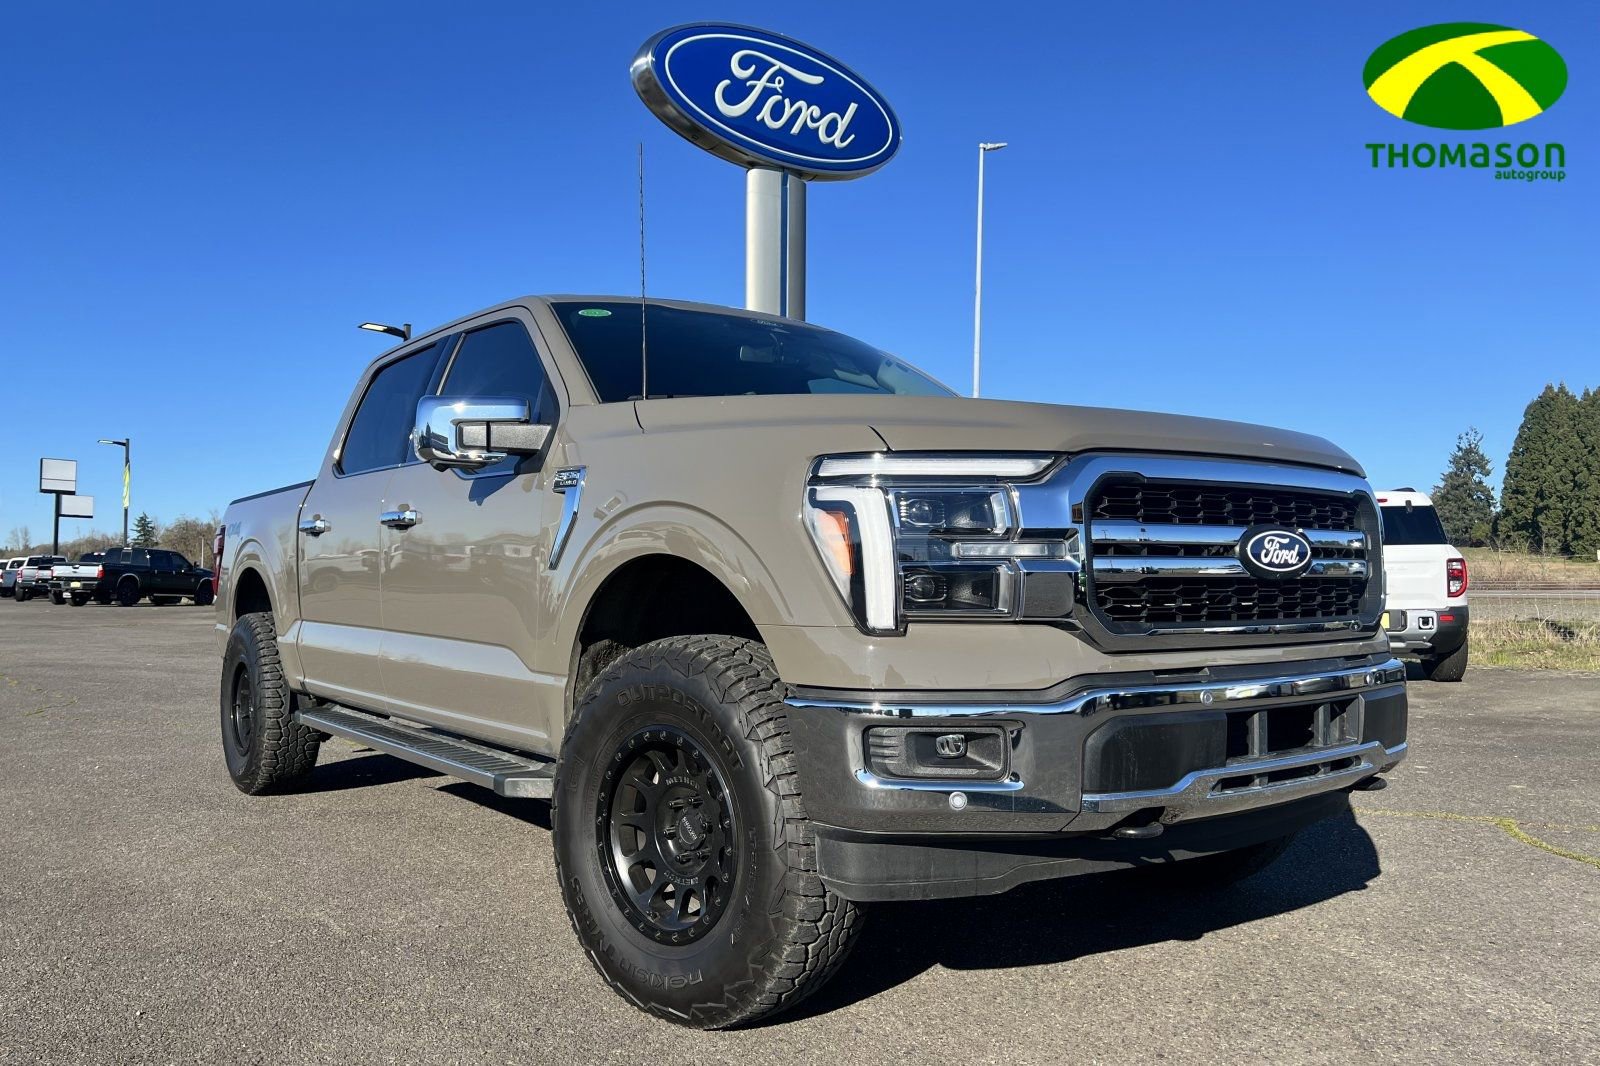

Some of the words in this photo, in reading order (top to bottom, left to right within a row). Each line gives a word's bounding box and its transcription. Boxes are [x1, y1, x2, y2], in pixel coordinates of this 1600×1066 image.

[715, 50, 858, 149] Ford
[1261, 536, 1300, 564] Ford
[617, 683, 712, 723] OUTPOST
